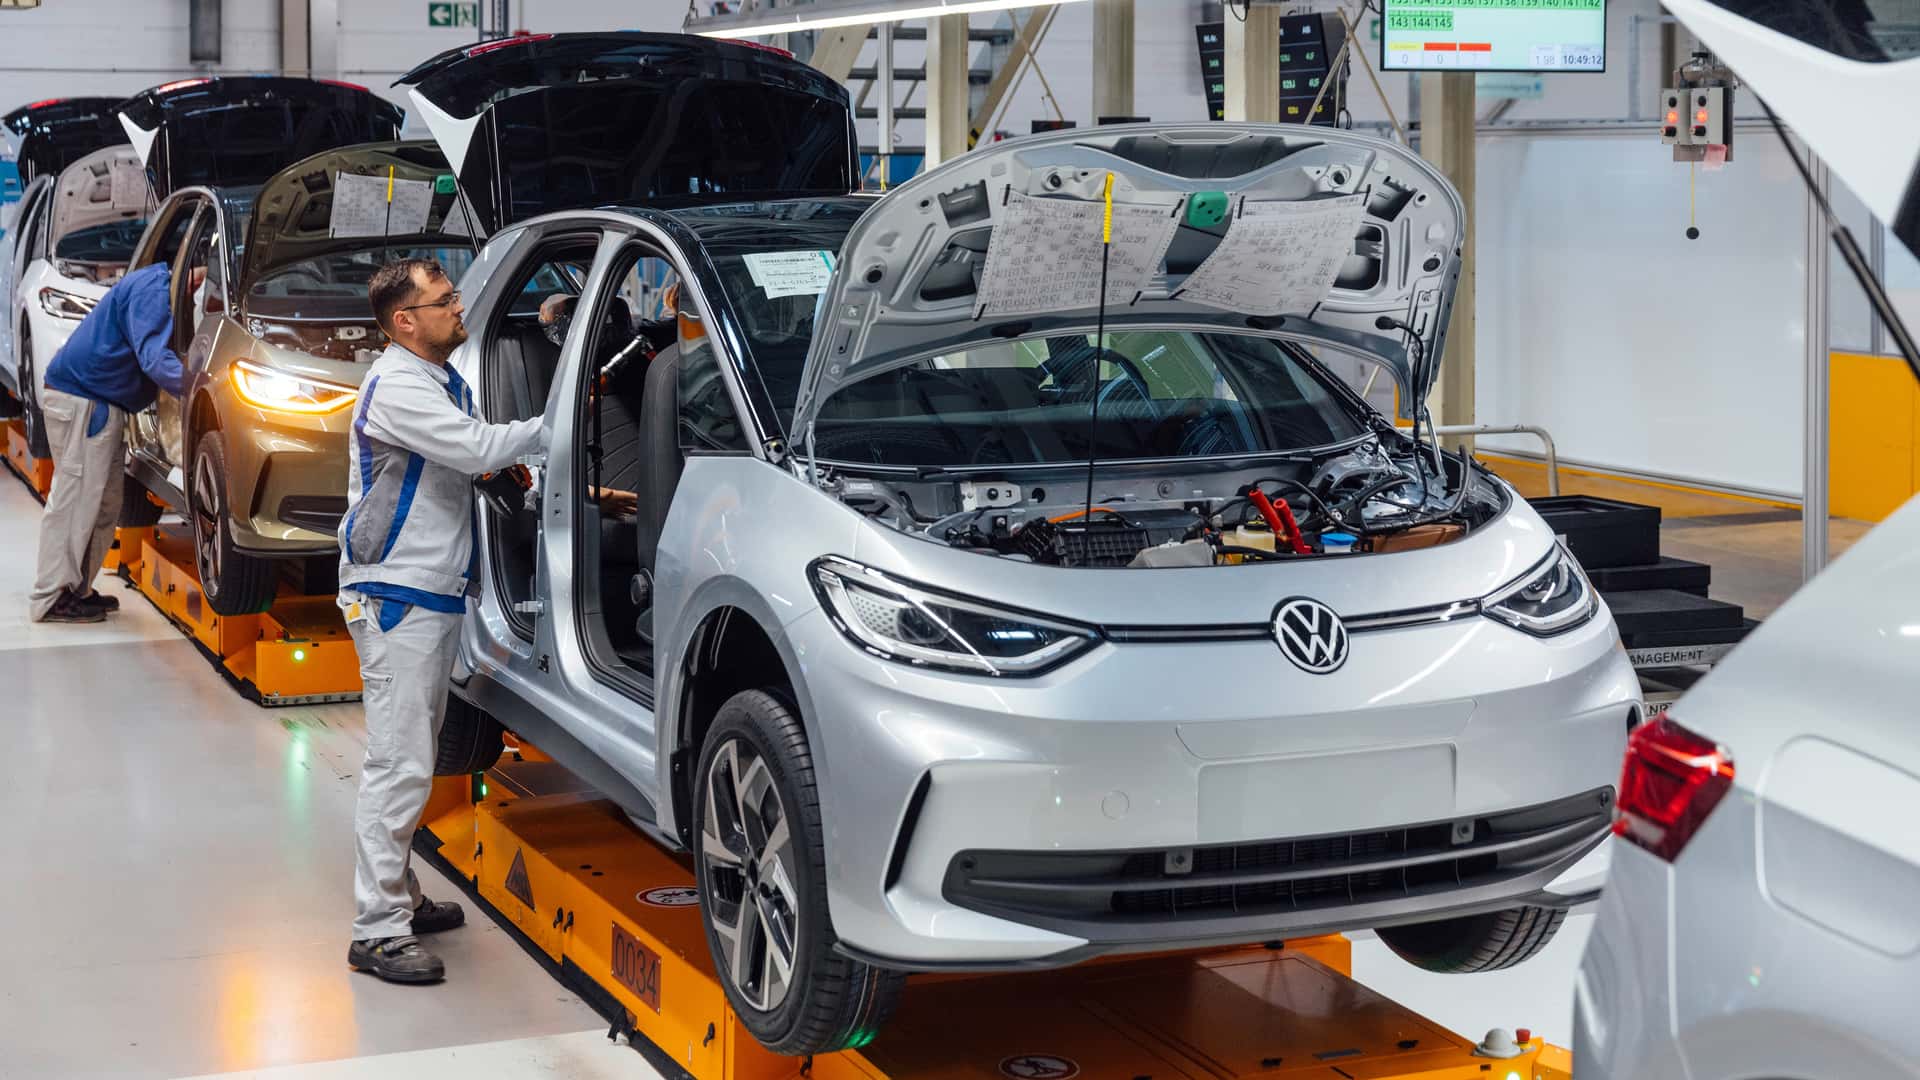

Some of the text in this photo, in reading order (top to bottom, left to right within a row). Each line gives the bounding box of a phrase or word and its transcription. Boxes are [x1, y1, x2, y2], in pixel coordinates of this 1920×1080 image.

[1391, 17, 1453, 28] 143 144 145
[1563, 55, 1602, 65] 10:49:12
[614, 933, 657, 1004] 0034
